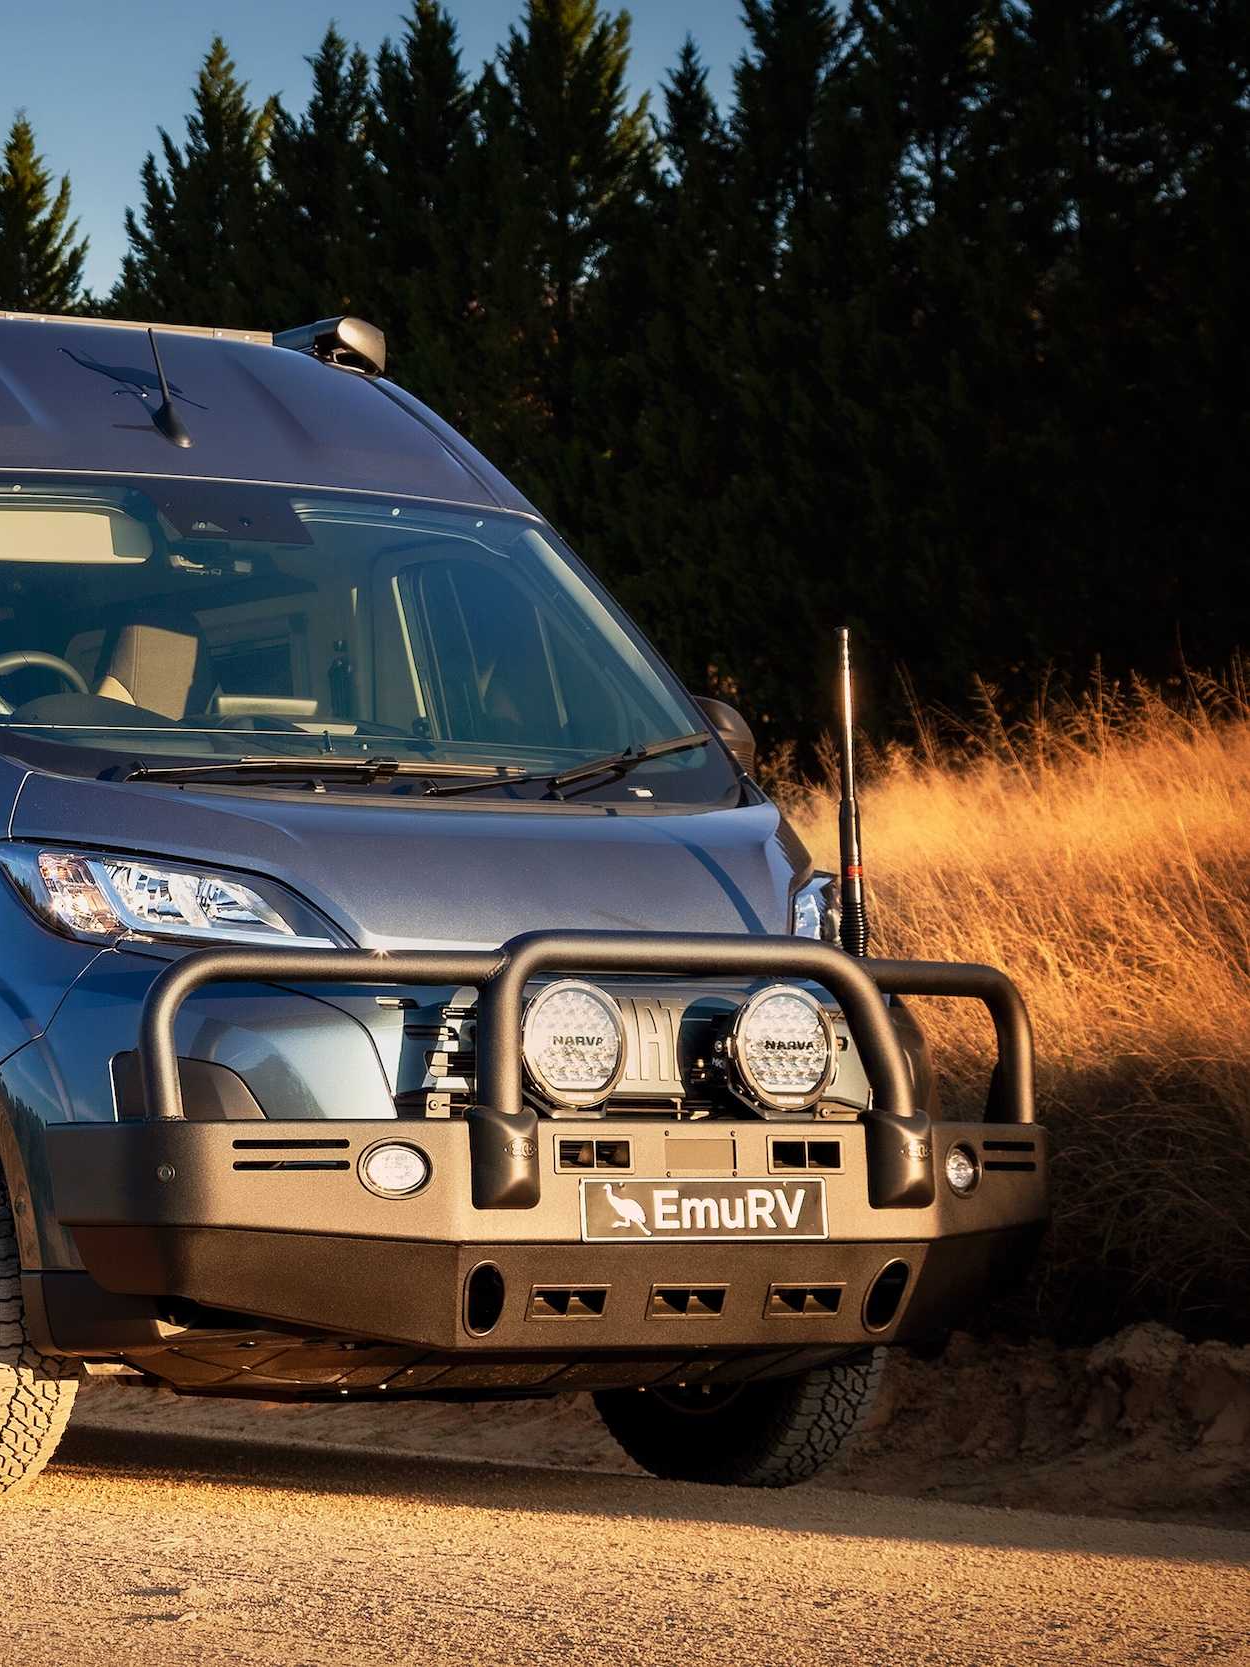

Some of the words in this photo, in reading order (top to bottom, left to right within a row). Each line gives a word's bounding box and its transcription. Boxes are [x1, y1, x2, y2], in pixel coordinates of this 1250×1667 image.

[553, 1035, 603, 1046] NARVA
[764, 1040, 813, 1050] NARVA
[653, 1189, 806, 1230] EmuRV
